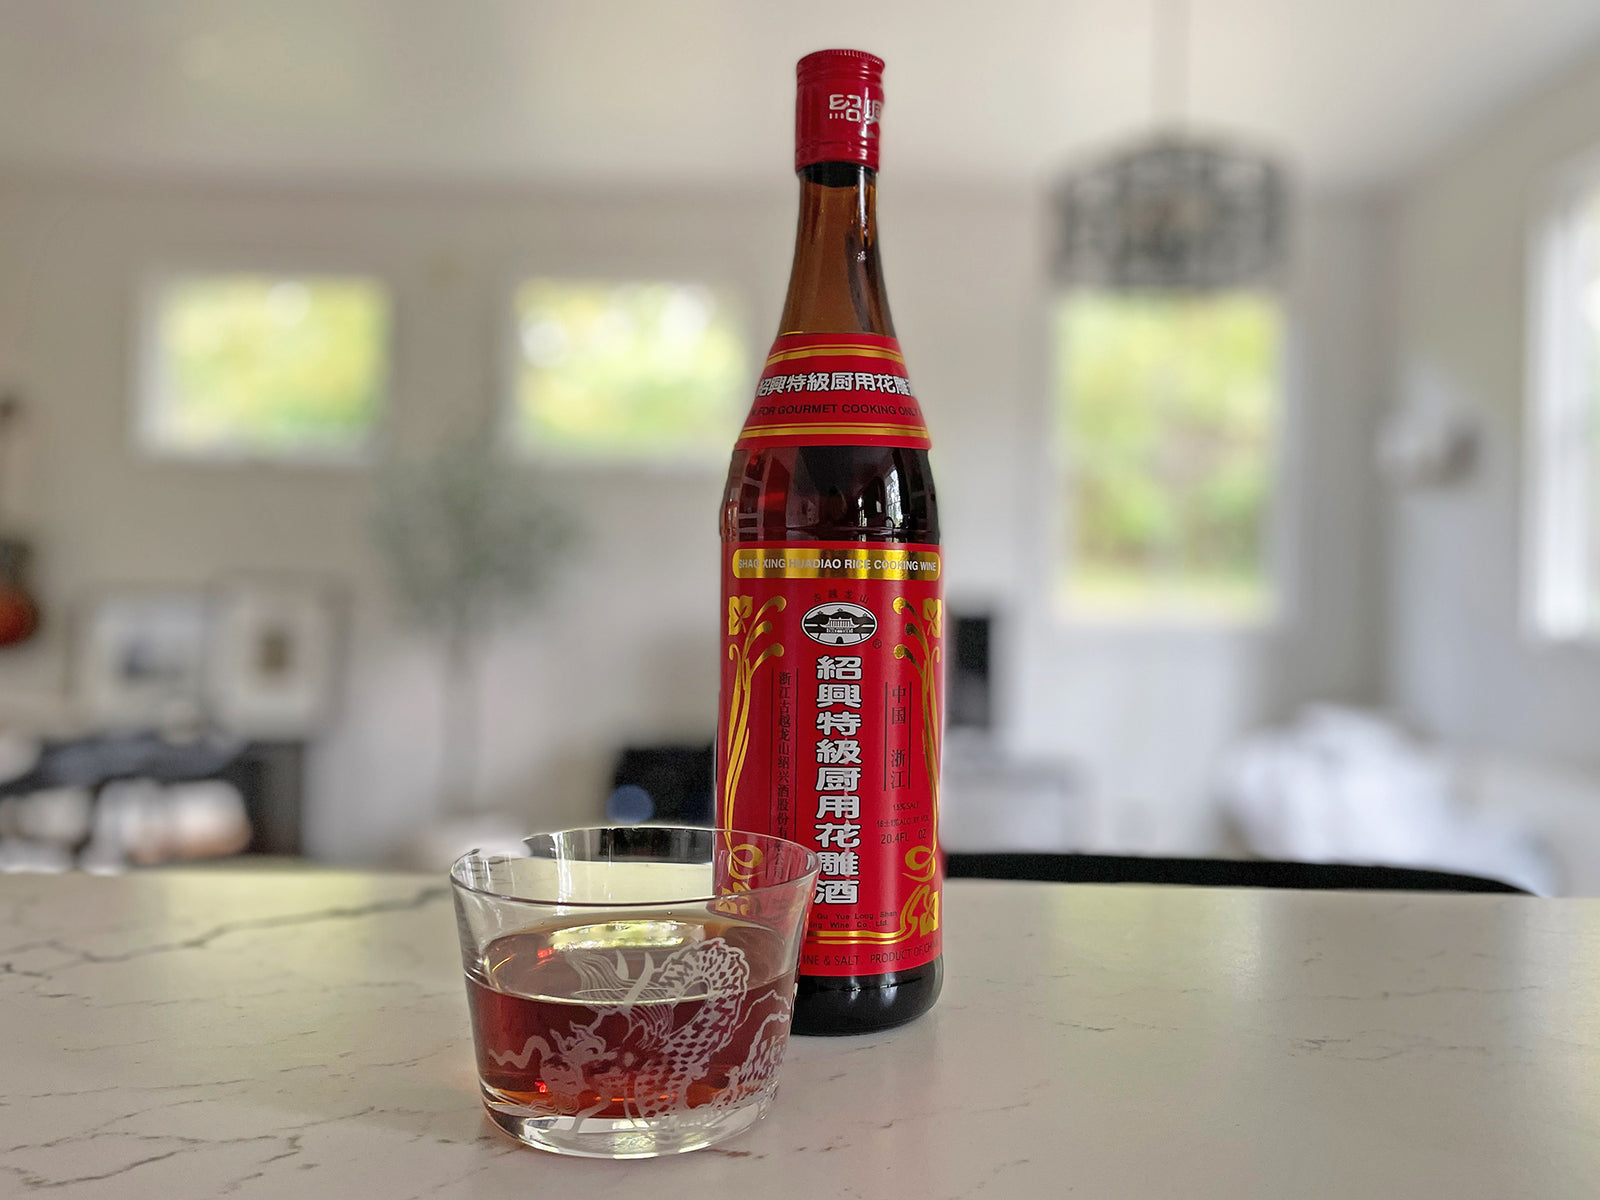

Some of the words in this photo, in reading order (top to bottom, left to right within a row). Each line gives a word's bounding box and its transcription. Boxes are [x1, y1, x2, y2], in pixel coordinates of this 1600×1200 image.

[758, 372, 912, 397] 紹興特級厨用花雕
[759, 406, 776, 416] FOR
[777, 404, 838, 415] GOURMET
[841, 404, 897, 415] COOKING
[738, 559, 759, 569] SHAO
[762, 558, 786, 569] XING
[788, 557, 841, 569] HUADIAO
[844, 558, 871, 569] RICE
[874, 559, 918, 571] COOKING
[920, 561, 937, 572] WINE
[892, 684, 906, 725] 中国
[890, 748, 906, 790] 浙江
[835, 912, 850, 920] Yue
[854, 912, 874, 920] Long
[830, 921, 850, 929] Wine
[802, 955, 820, 966] INE
[823, 955, 831, 965] &
[870, 948, 911, 965] PRODUCT
